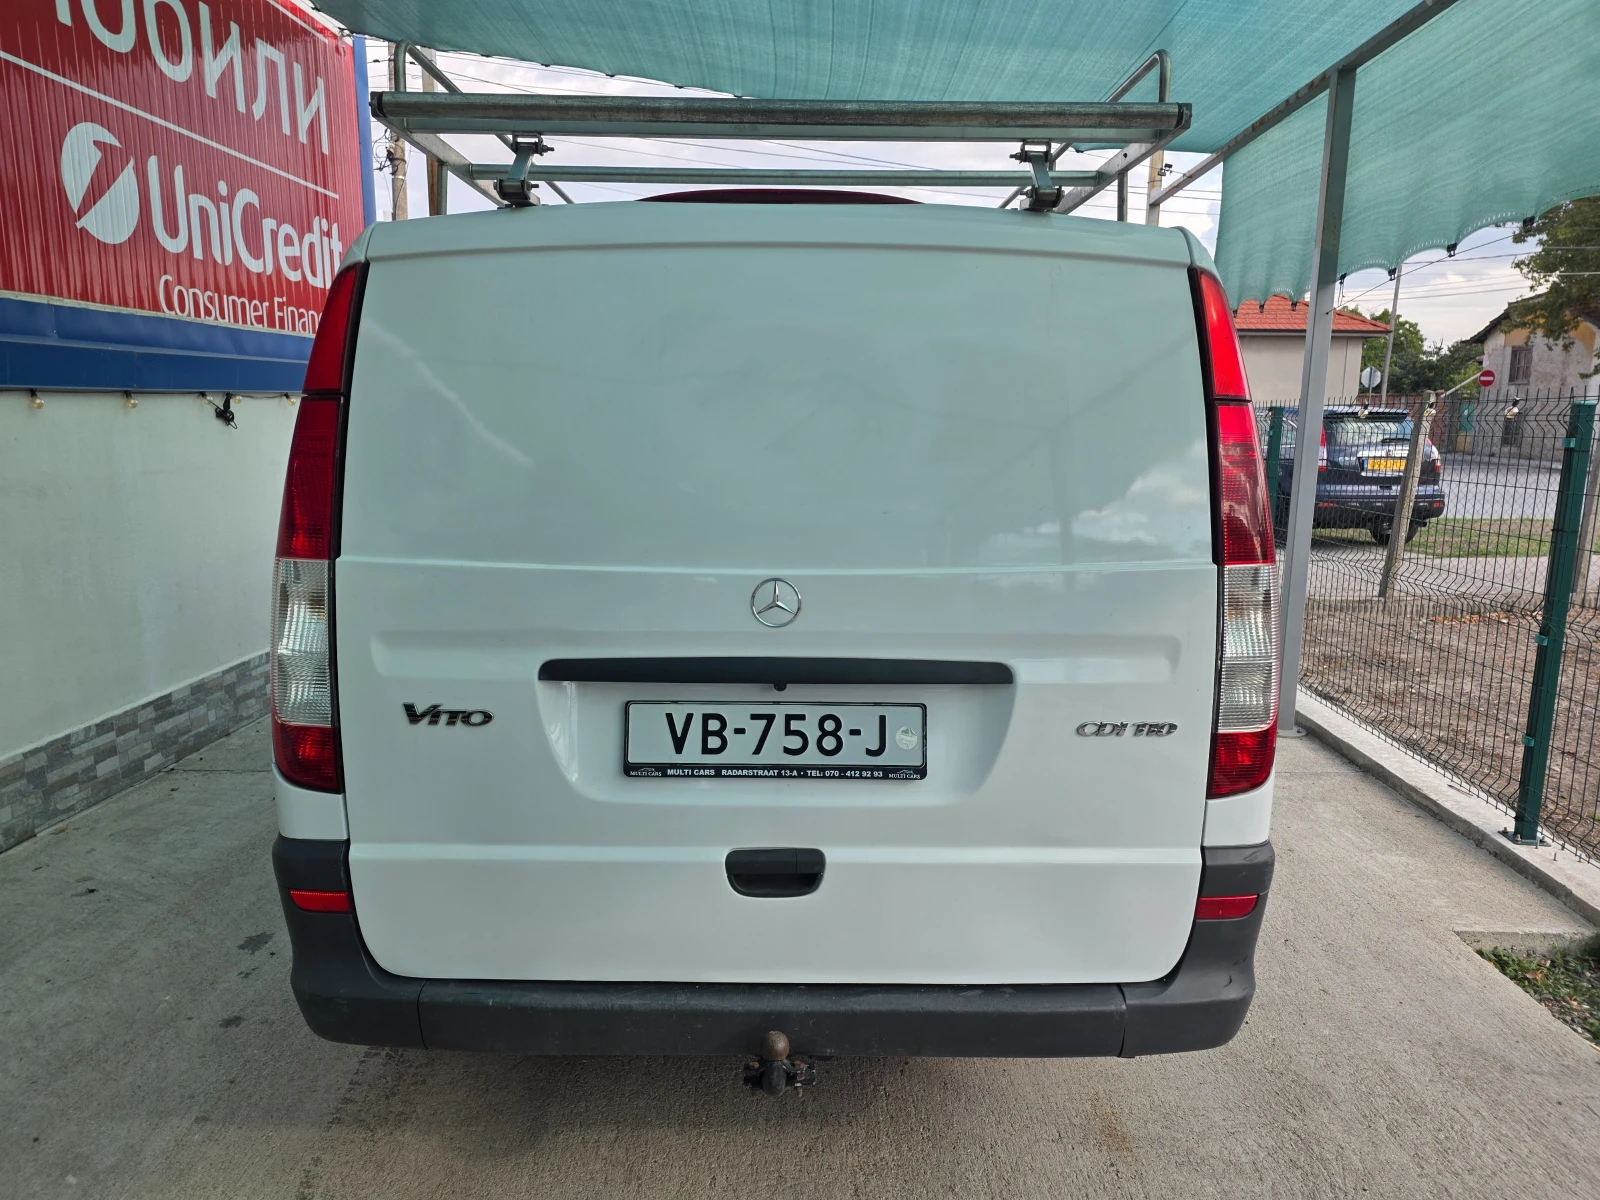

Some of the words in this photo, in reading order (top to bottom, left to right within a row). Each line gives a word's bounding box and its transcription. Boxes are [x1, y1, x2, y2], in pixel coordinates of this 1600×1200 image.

[147, 155, 343, 289] UniCredit
[159, 274, 270, 328] Consumer
[273, 297, 322, 335] Finan
[665, 712, 888, 757] VB-758-J
[667, 768, 692, 776] MULTI
[721, 769, 779, 777] RADARSTRAAT
[780, 769, 798, 777] 13-A
[873, 770, 884, 778] 93
